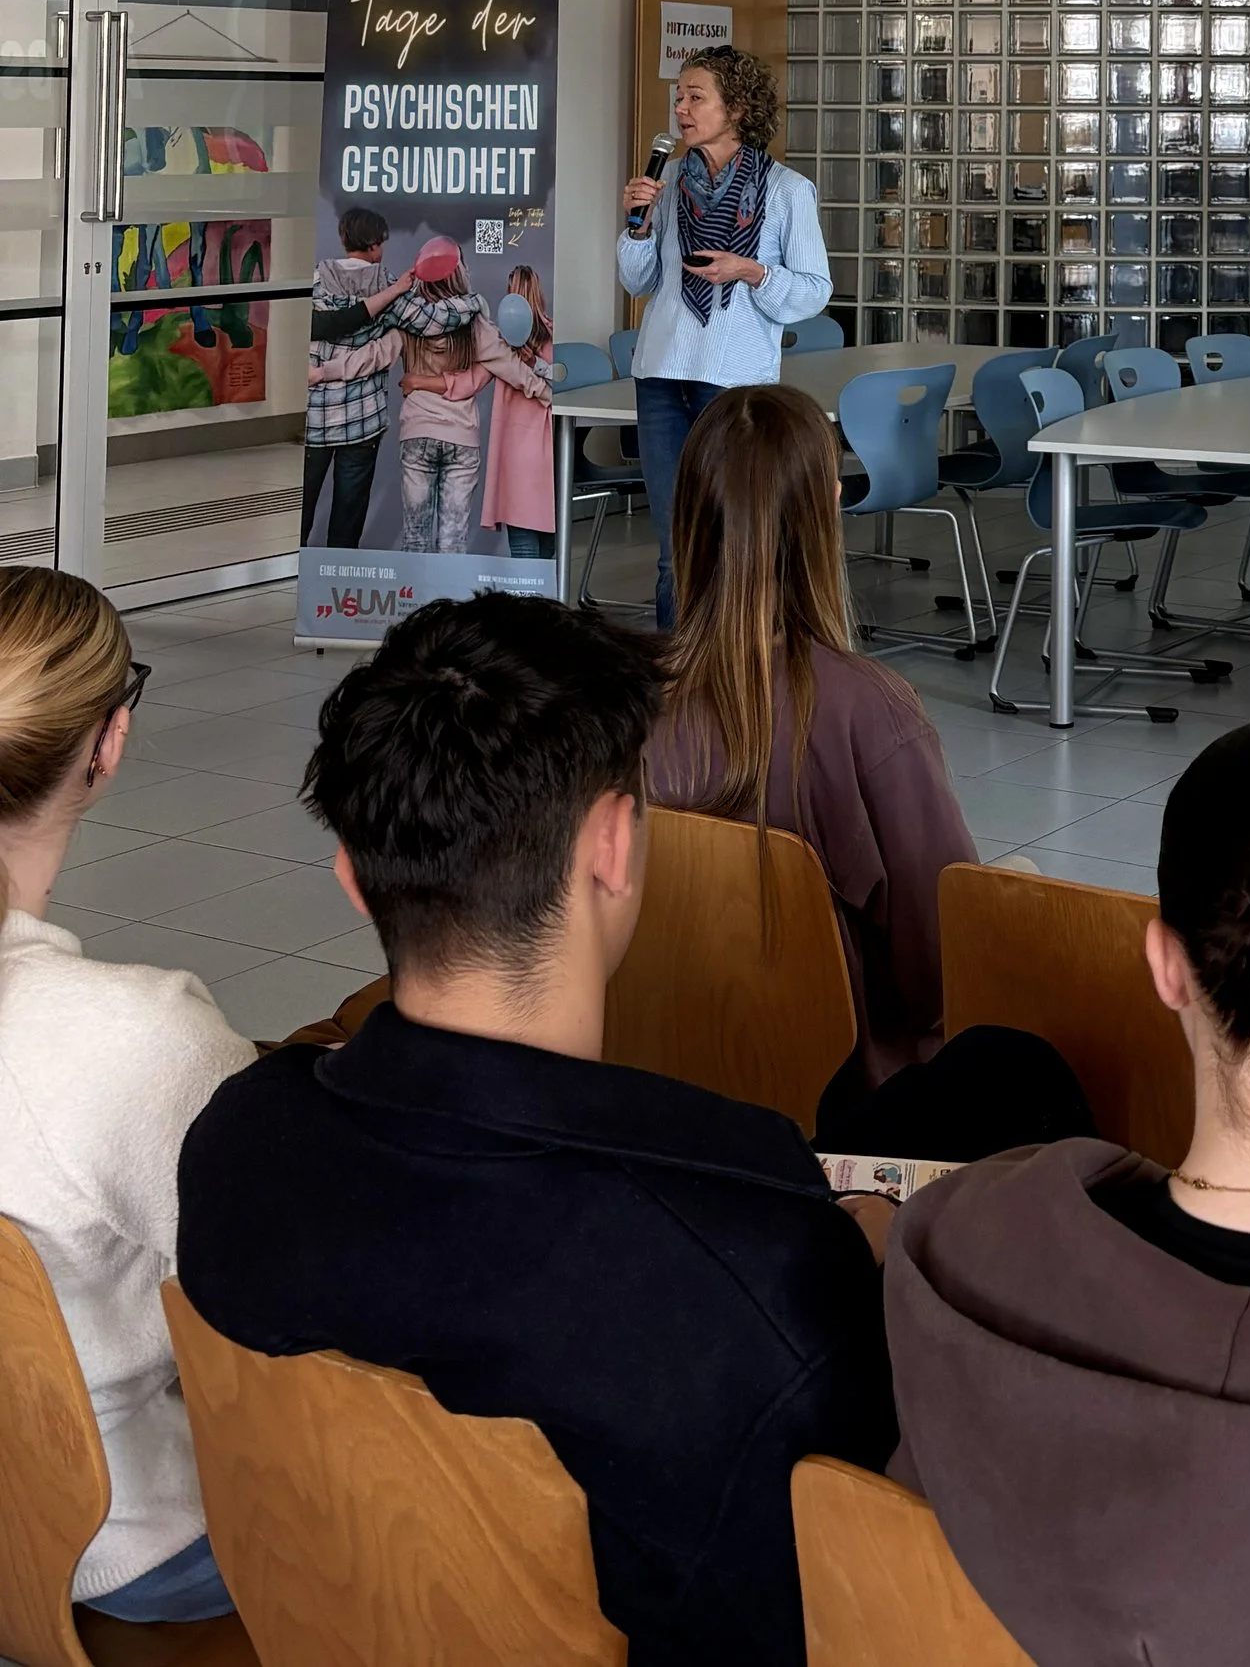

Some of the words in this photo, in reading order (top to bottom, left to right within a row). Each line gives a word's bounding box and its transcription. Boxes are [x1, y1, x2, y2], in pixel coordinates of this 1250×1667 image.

[666, 21, 727, 38] MITTAGESSEN
[344, 84, 538, 130] PSYCHISCHEN
[341, 145, 536, 195] GESUNDHEIT
[320, 564, 336, 577] EINE
[338, 565, 376, 579] INITIATIVE
[378, 567, 397, 580] VON:
